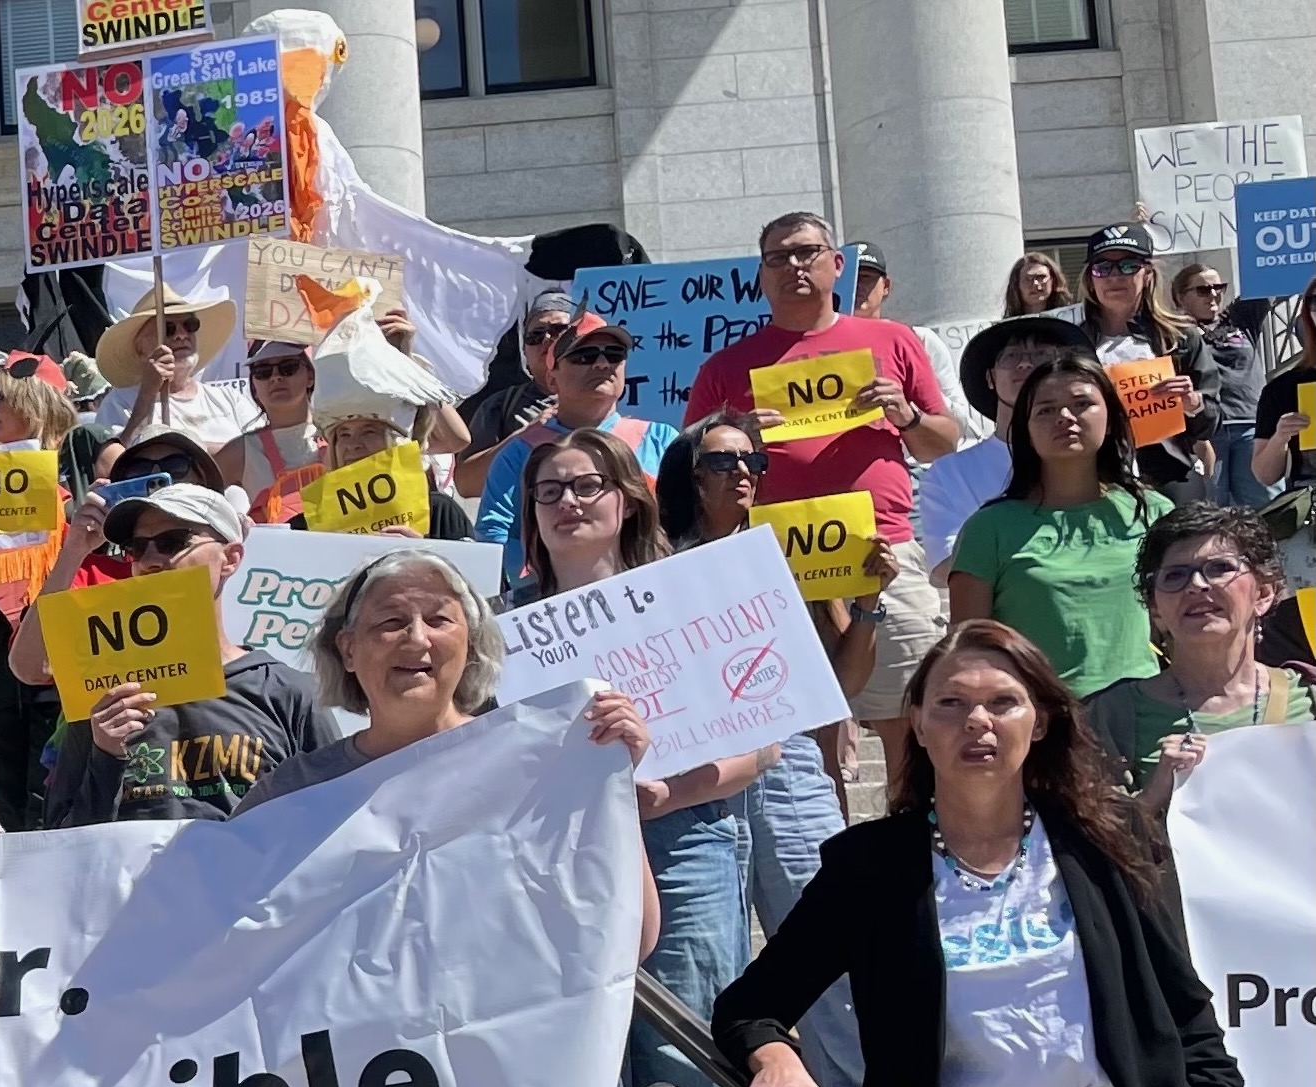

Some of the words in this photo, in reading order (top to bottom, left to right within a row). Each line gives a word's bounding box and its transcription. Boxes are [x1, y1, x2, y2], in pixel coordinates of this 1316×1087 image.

[82, 6, 205, 47] SWINDLE
[151, 69, 196, 89] Great
[201, 62, 234, 82] Salt
[237, 58, 277, 76] Lake
[190, 50, 236, 69] Save
[61, 61, 143, 112] NO
[221, 87, 278, 109] 1985
[80, 103, 145, 142] 2026
[1140, 129, 1197, 171] WE
[1214, 123, 1284, 166] THE
[157, 158, 210, 186] NO
[158, 167, 283, 199] HYPERSCALE
[27, 172, 149, 213] Hyperscale
[63, 197, 147, 224] Data
[160, 202, 222, 222] Adams
[160, 216, 224, 233] Schultz
[236, 200, 285, 220] 2026
[1254, 209, 1288, 222] KEEP
[36, 214, 143, 242] Center
[160, 215, 285, 249] SWINDLE
[1150, 210, 1205, 251] SAY
[30, 229, 152, 267] SWINDLE
[253, 242, 306, 267] YOU
[320, 252, 399, 280] CAN'T
[1256, 254, 1287, 268] BOX
[595, 275, 668, 316] SAVE
[681, 273, 724, 305] OUR
[653, 320, 694, 352] the
[787, 373, 844, 408] NO
[1124, 388, 1149, 405] TO
[783, 416, 812, 428] DATA
[814, 408, 859, 424] CENTER
[336, 473, 397, 516] NO
[0, 506, 38, 517] CENTER
[785, 520, 847, 558] NO
[803, 565, 852, 582] CENTER
[87, 604, 169, 656] NO
[504, 588, 617, 656] Listen
[623, 585, 656, 614] to
[531, 640, 579, 668] YOUR
[84, 673, 122, 692] DATA
[126, 662, 188, 683] CENTER
[170, 734, 264, 782] KZMU
